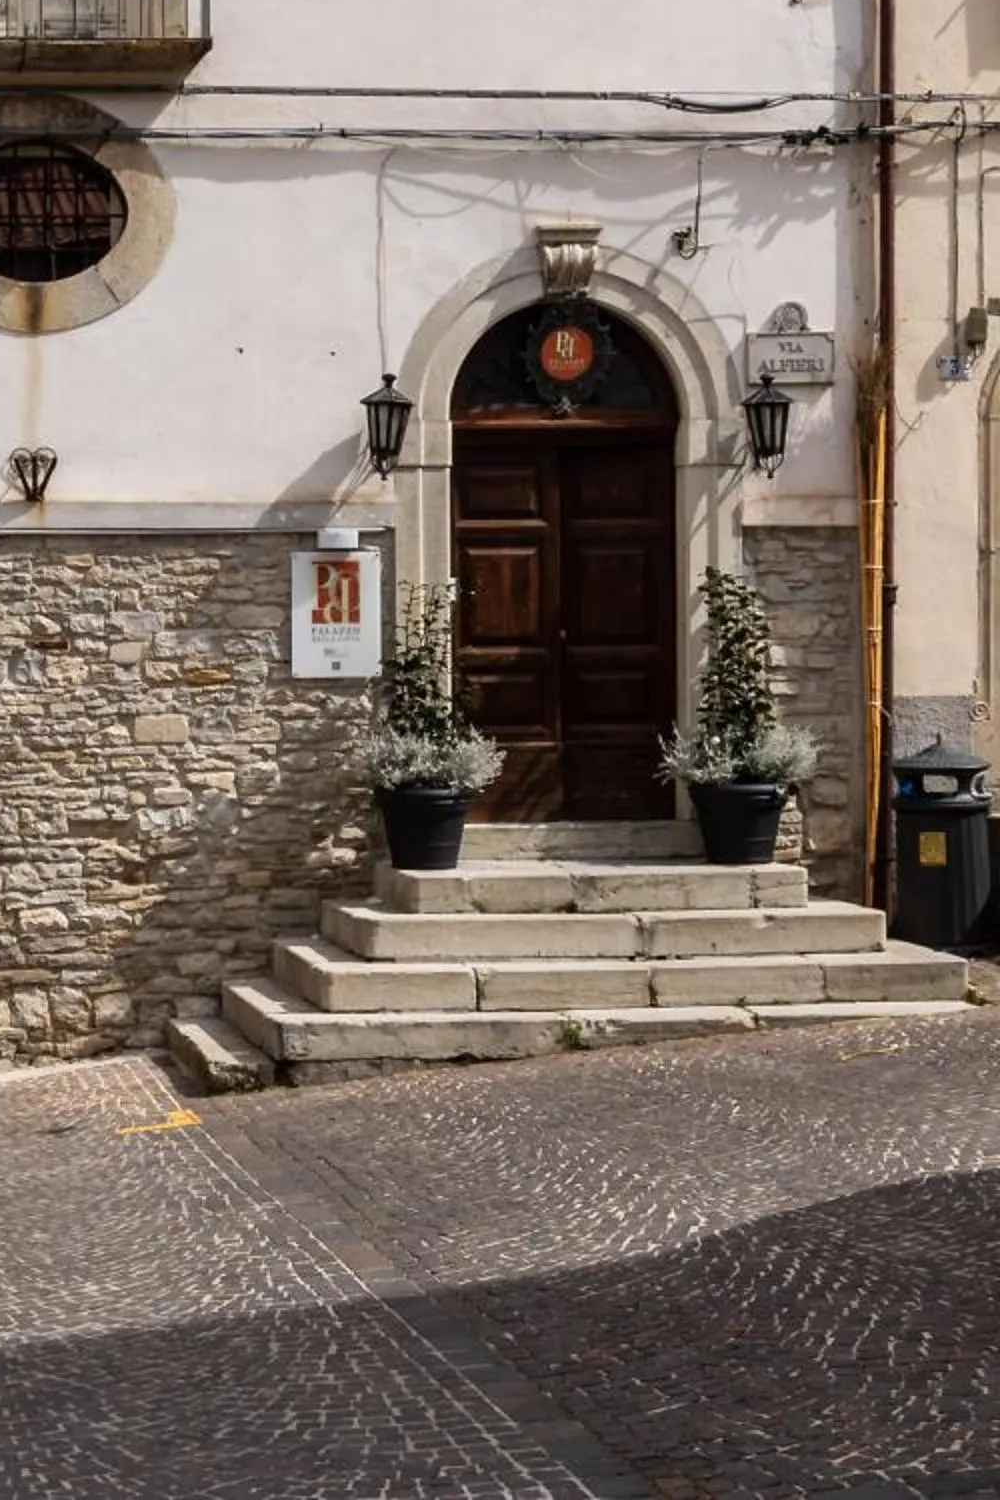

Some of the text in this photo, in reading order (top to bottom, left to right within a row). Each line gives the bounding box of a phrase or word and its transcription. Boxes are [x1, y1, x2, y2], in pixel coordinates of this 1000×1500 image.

[778, 341, 804, 354] VIA
[757, 358, 826, 373] ALFIERI
[311, 627, 361, 636] PALAZZO
